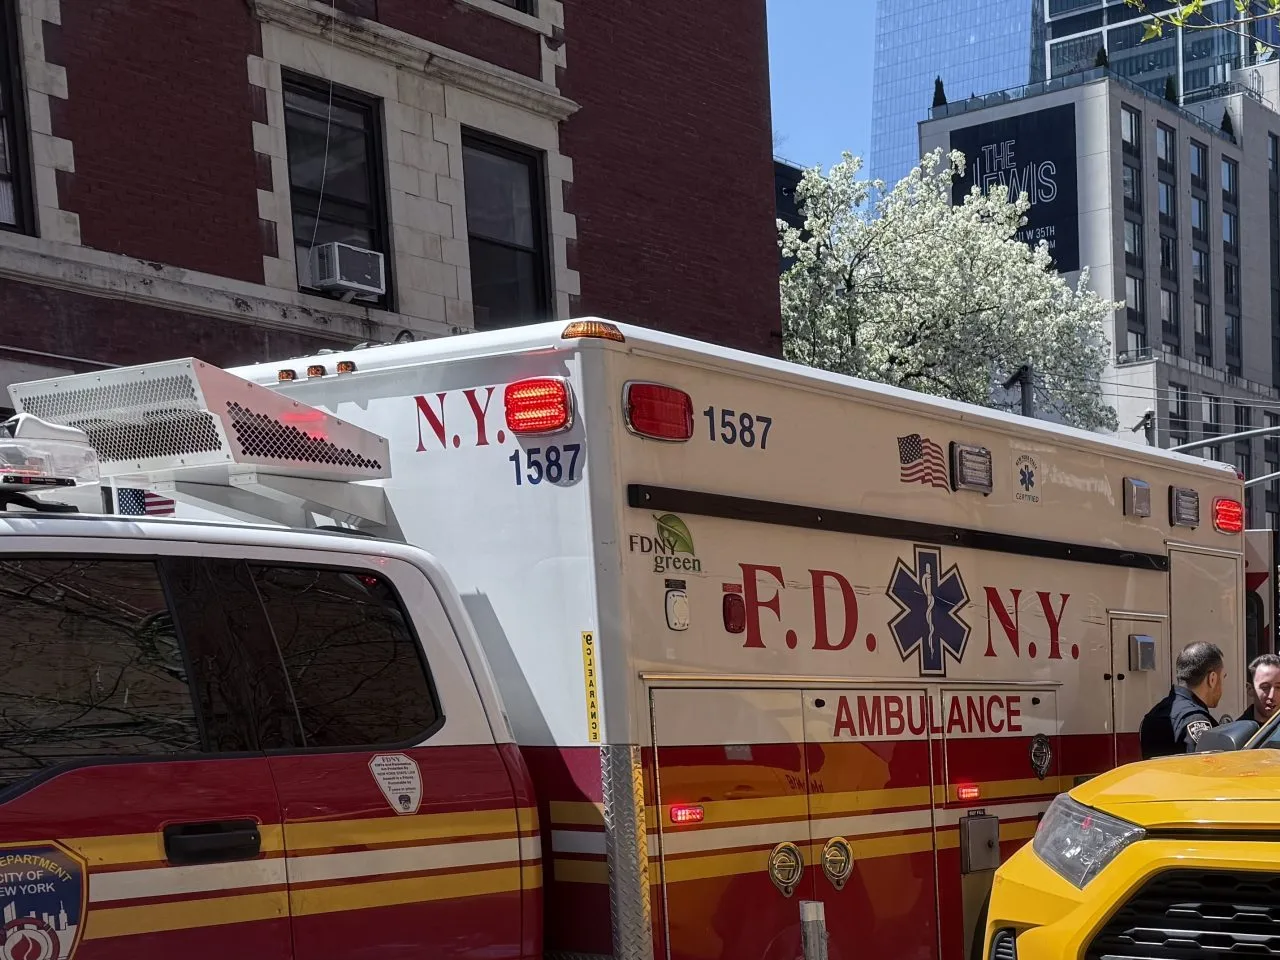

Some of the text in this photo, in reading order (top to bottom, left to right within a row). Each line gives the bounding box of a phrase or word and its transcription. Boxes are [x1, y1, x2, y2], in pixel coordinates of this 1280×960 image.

[981, 139, 1017, 173] THE
[1026, 230, 1034, 240] W
[1035, 225, 1055, 239] 35TH
[413, 386, 506, 452] N.Y.
[703, 405, 772, 450] 1587
[508, 443, 581, 486] 1587
[629, 534, 678, 555] FDNY
[653, 554, 701, 573] green
[738, 563, 1080, 660] F.D. N.Y.
[833, 694, 1023, 738] AMBULANCE
[0, 854, 72, 883] EPARTMENT
[26, 870, 44, 881] OF
[0, 882, 56, 897] EW YORK
